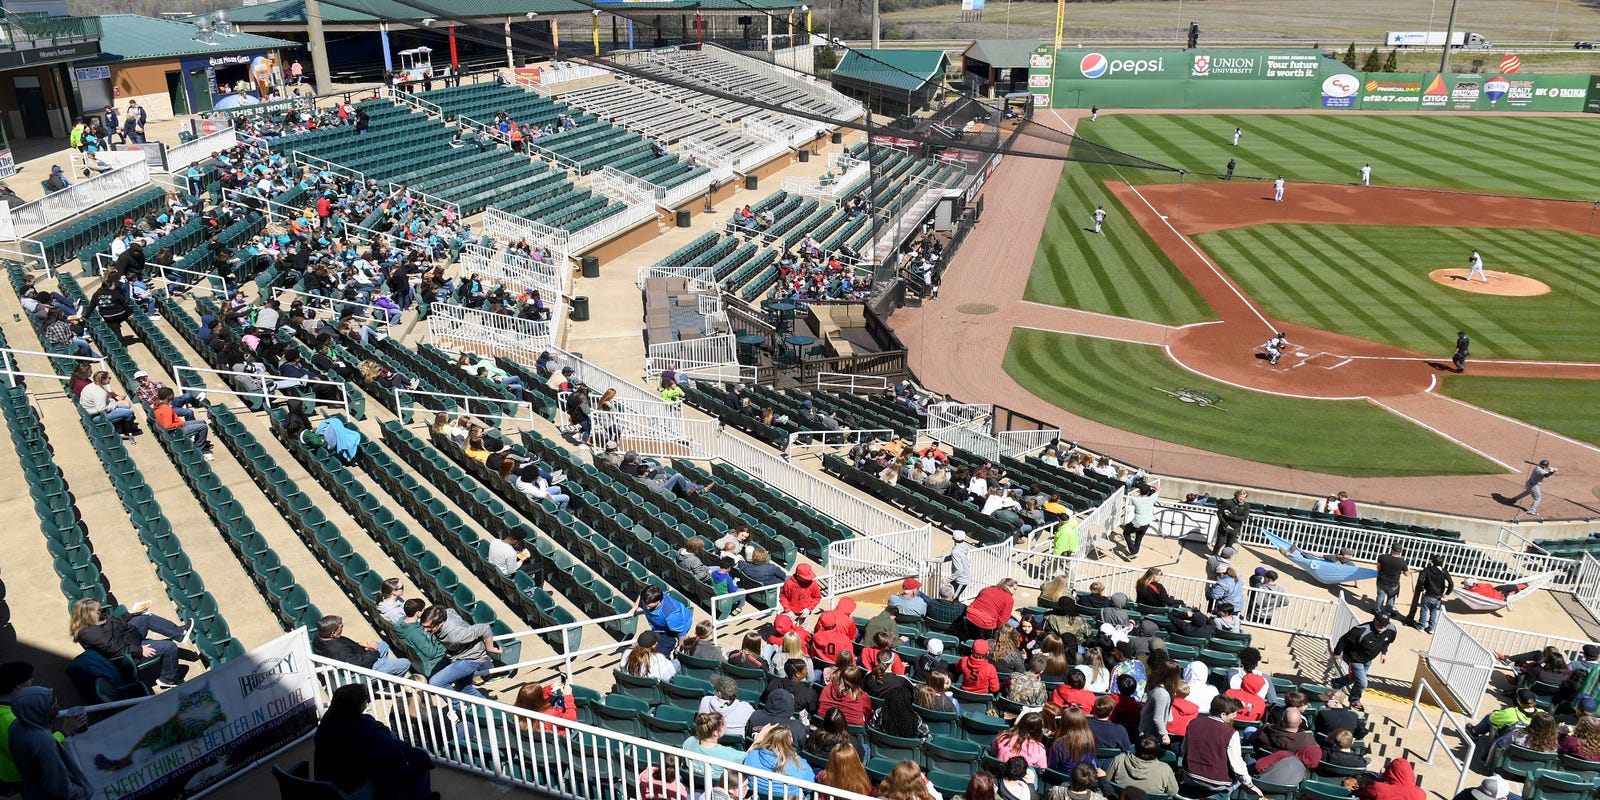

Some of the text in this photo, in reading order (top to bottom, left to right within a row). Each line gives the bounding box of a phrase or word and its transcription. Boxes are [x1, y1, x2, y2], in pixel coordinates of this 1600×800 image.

[1109, 57, 1164, 75] pepsi
[1213, 58, 1254, 68] UNION
[1267, 60, 1318, 69] Your future
[1266, 69, 1315, 77] is worth it.
[231, 108, 253, 119] THIS
[255, 106, 265, 115] IS
[267, 102, 292, 112] HOME
[103, 748, 186, 800] EVERYTHING
[188, 741, 203, 759] IS
[203, 717, 250, 750] BETTER
[251, 709, 265, 726] IN
